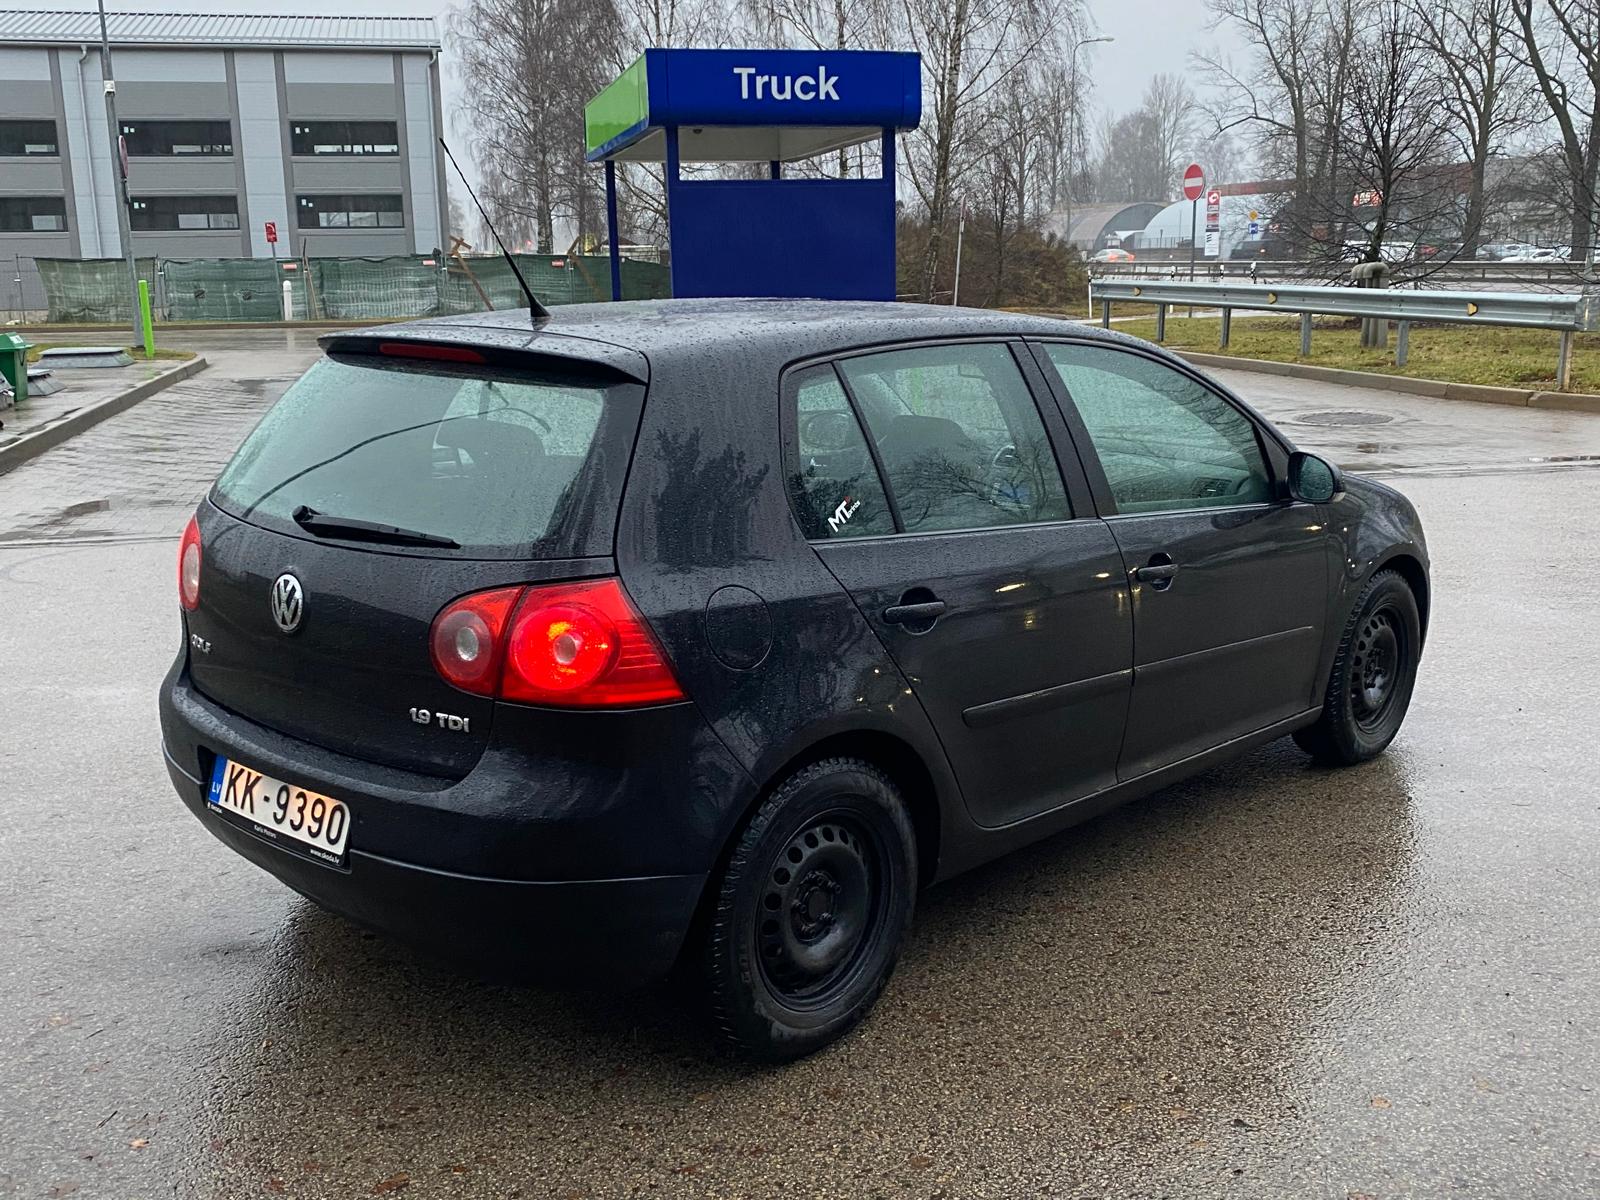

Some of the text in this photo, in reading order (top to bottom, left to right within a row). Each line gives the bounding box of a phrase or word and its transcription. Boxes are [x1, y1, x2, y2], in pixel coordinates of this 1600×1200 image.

[733, 65, 840, 101] Truck
[827, 499, 850, 533] MT
[409, 707, 470, 733] 1.9 TDI
[211, 781, 222, 794] LV
[224, 763, 346, 846] KK-9390
